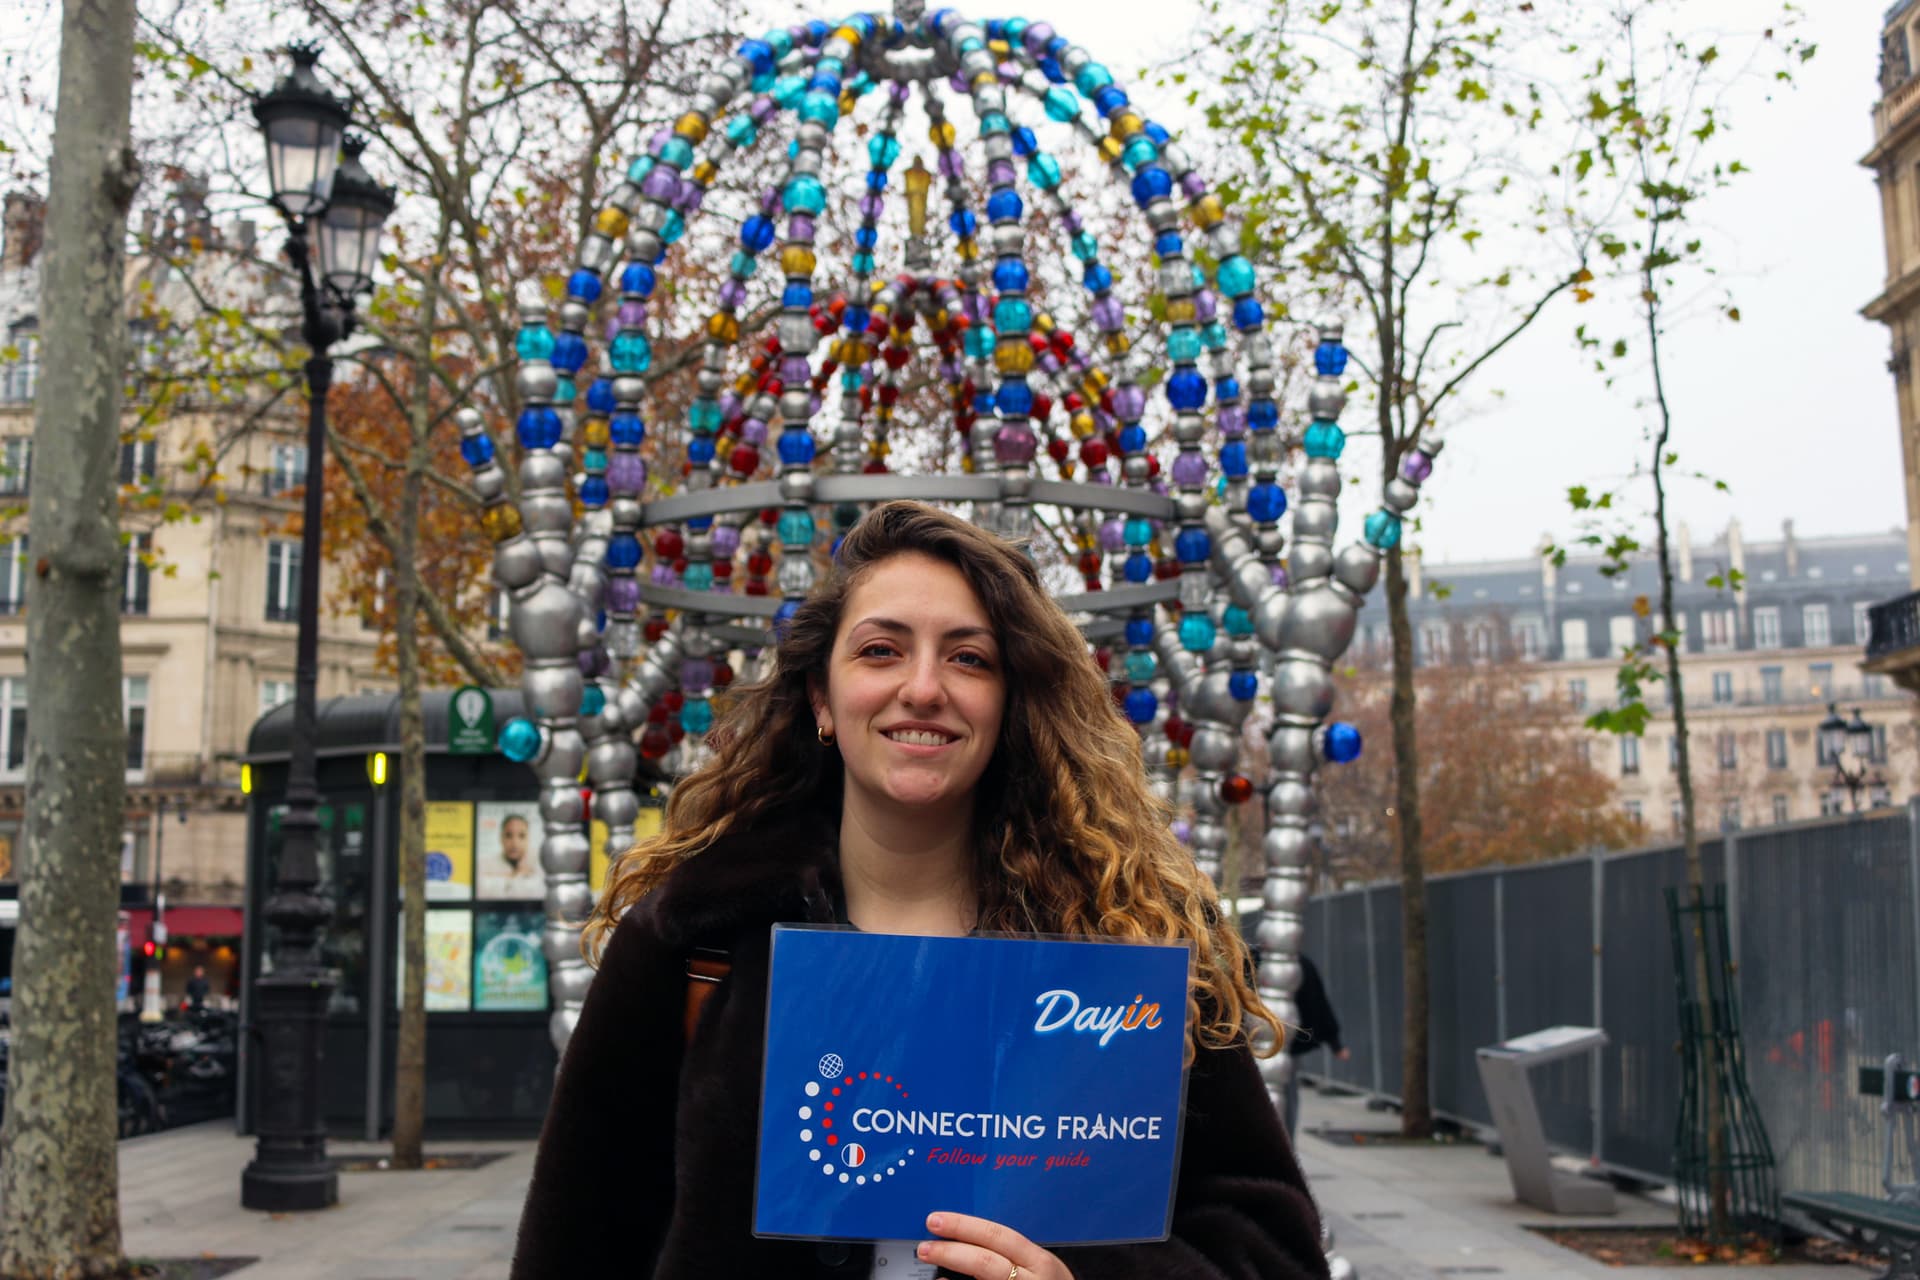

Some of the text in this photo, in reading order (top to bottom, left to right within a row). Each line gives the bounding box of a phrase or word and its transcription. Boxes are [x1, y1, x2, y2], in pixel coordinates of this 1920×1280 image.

[1034, 989, 1162, 1046] Dayin
[852, 1107, 1163, 1140] CONNECTING FRANCE
[927, 1146, 1091, 1172] Follow your guide
